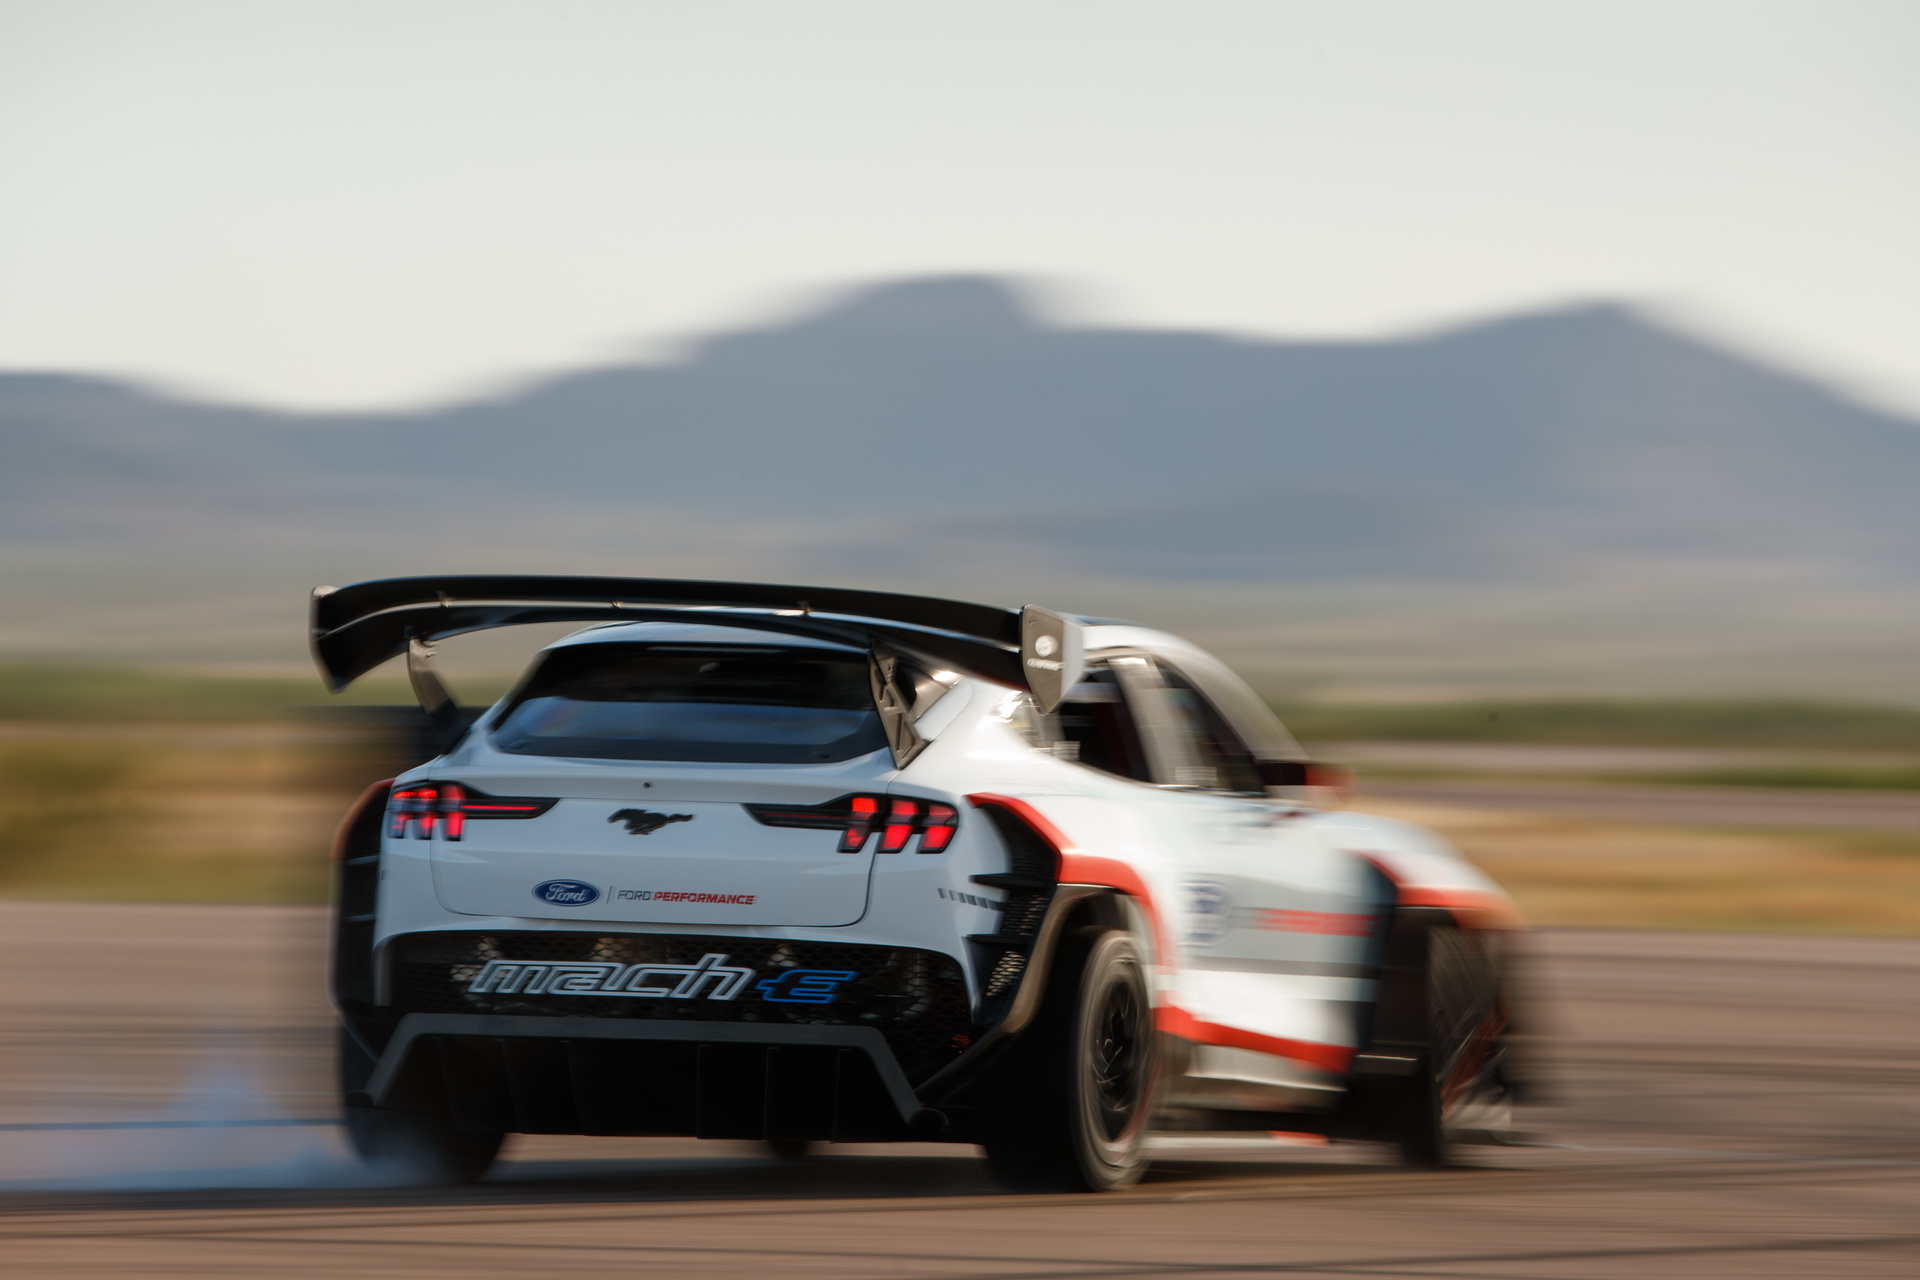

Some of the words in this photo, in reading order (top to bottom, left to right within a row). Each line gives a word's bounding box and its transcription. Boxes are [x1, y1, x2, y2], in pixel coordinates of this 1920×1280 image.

[545, 882, 588, 902] Ford
[617, 889, 651, 901] FORD
[653, 891, 756, 905] PERFORMANCE
